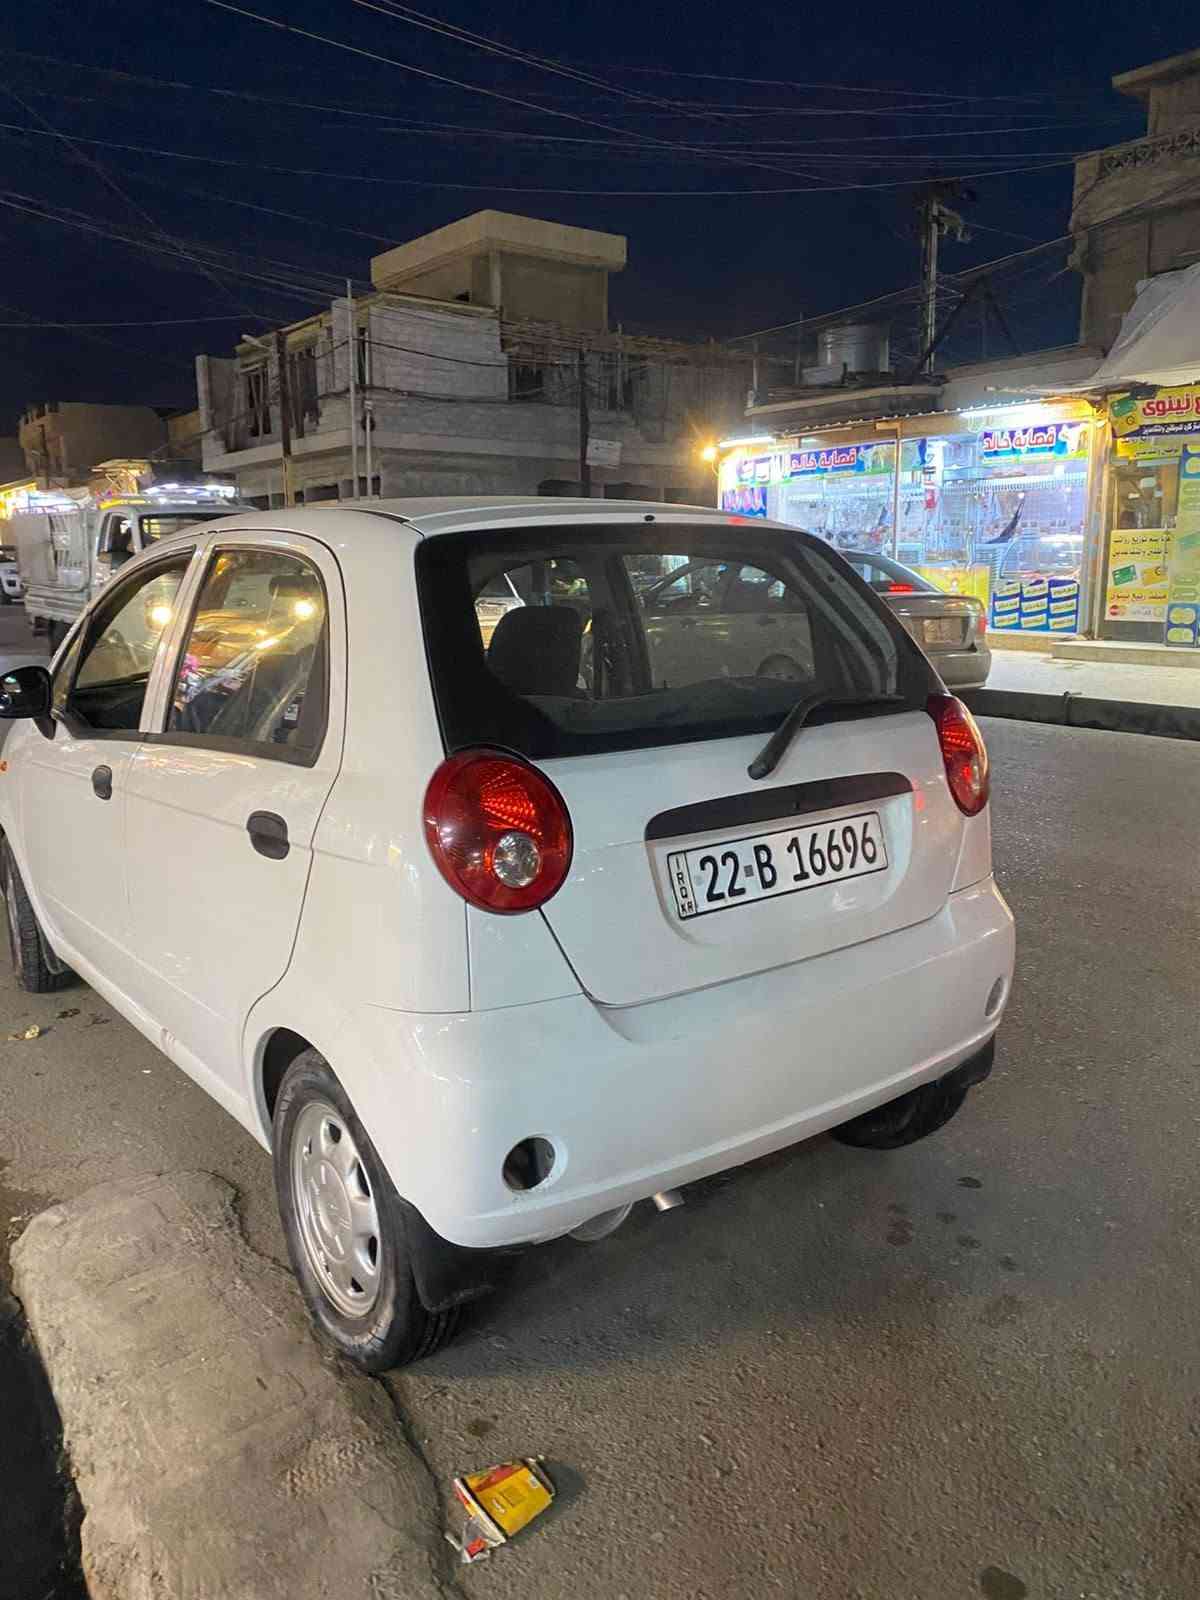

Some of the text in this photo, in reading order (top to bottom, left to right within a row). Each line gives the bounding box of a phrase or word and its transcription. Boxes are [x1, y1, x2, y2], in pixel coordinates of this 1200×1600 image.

[1143, 394, 1191, 416] نينوى
[1014, 427, 1056, 449] قصابة
[819, 448, 857, 469] قصابة
[786, 822, 876, 882] 16696
